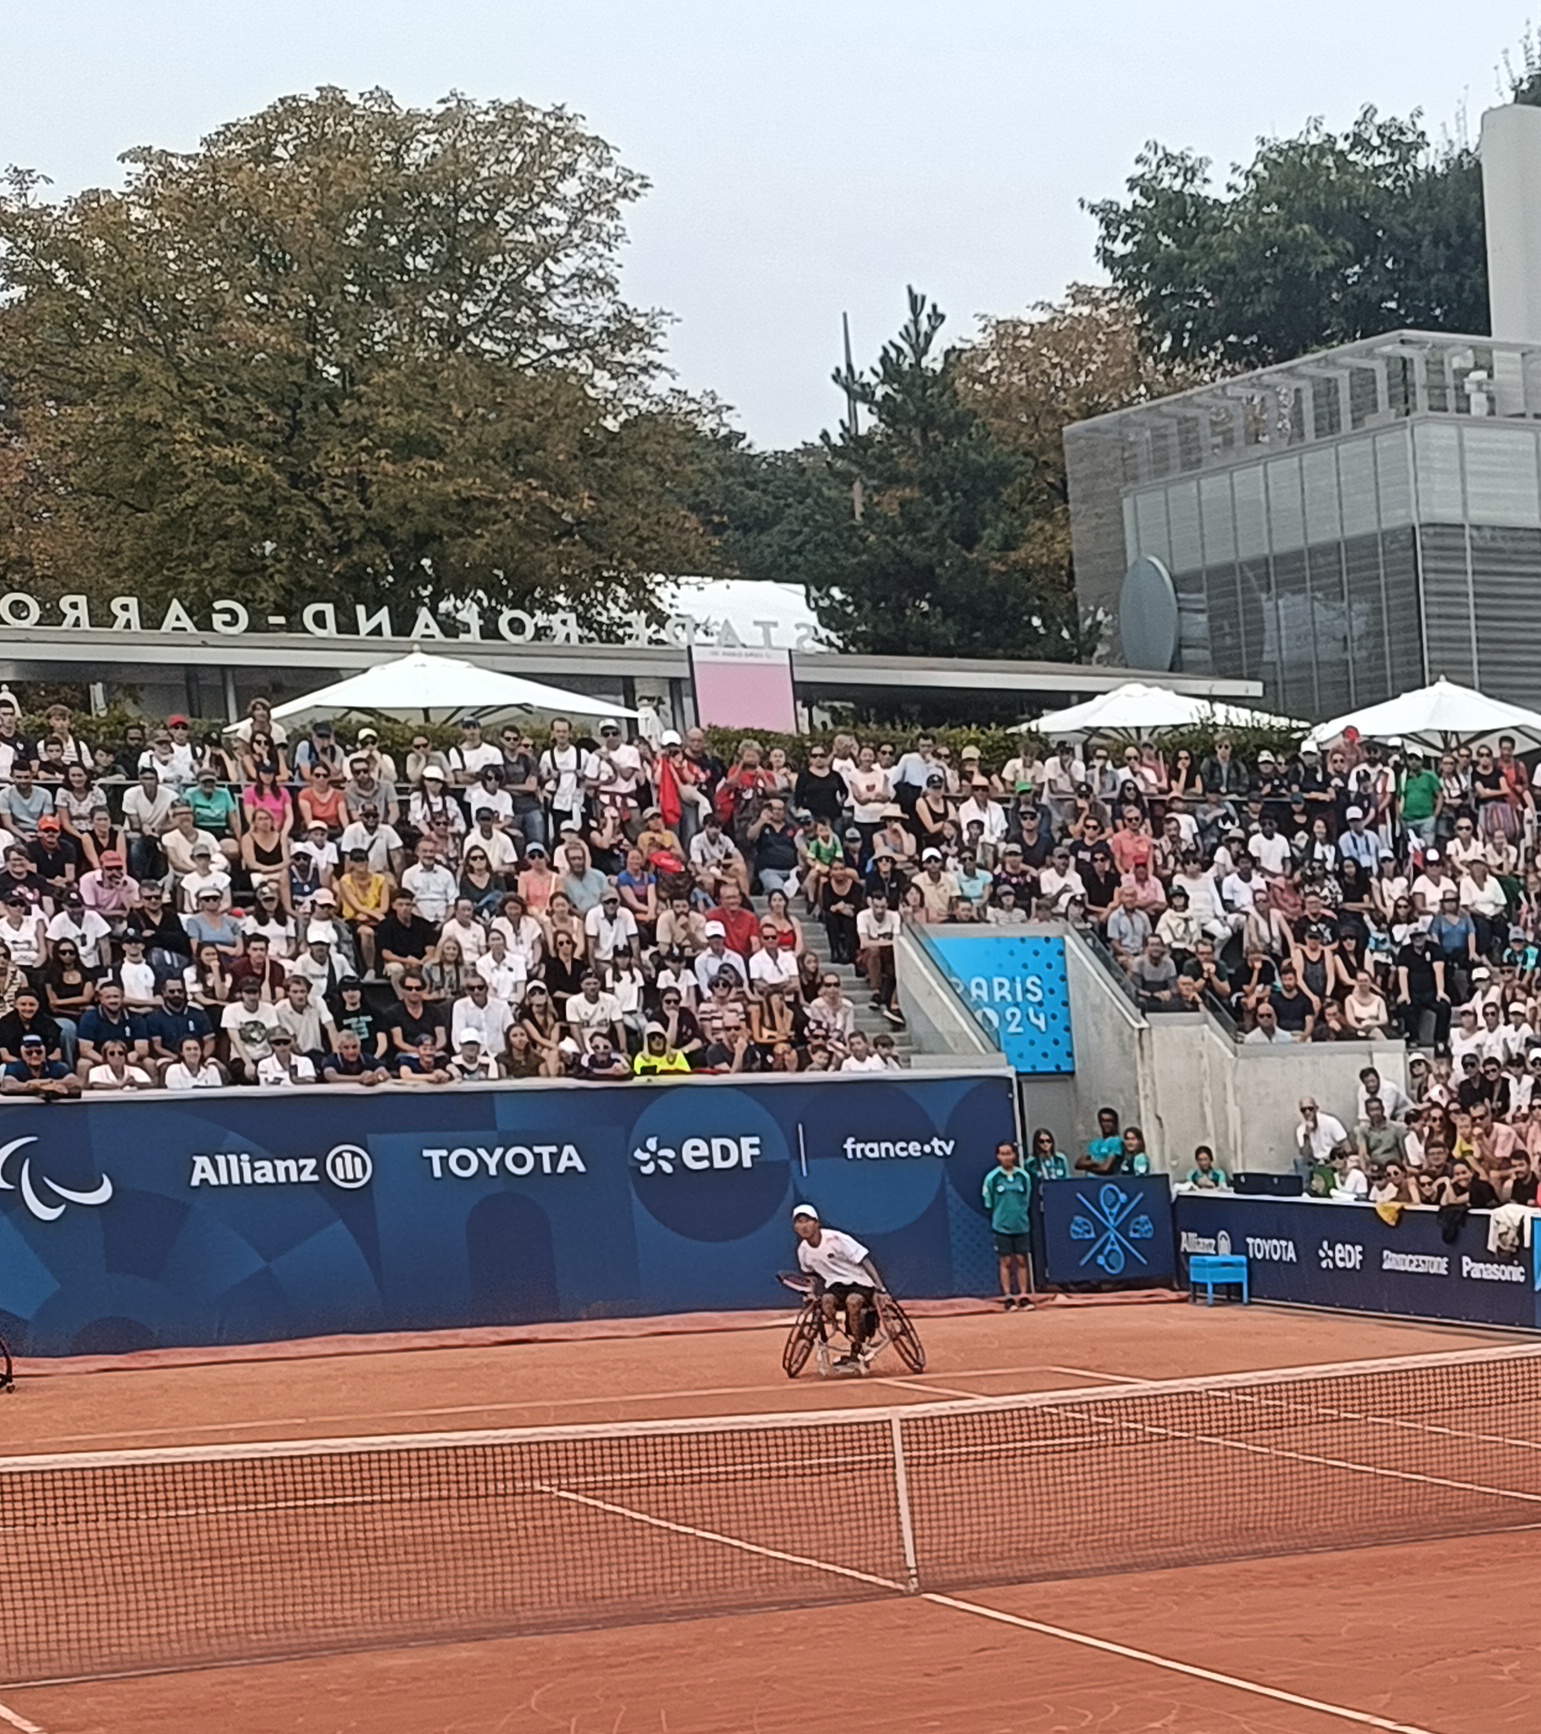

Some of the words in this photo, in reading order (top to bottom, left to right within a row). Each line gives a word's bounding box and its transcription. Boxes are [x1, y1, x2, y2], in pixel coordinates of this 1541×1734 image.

[974, 1006, 1047, 1035] 024
[190, 1154, 319, 1187] Allianz
[423, 1144, 587, 1178] TOYOTA
[1246, 1236, 1297, 1263] TOYOTA
[1461, 1254, 1526, 1283] Panasonic
